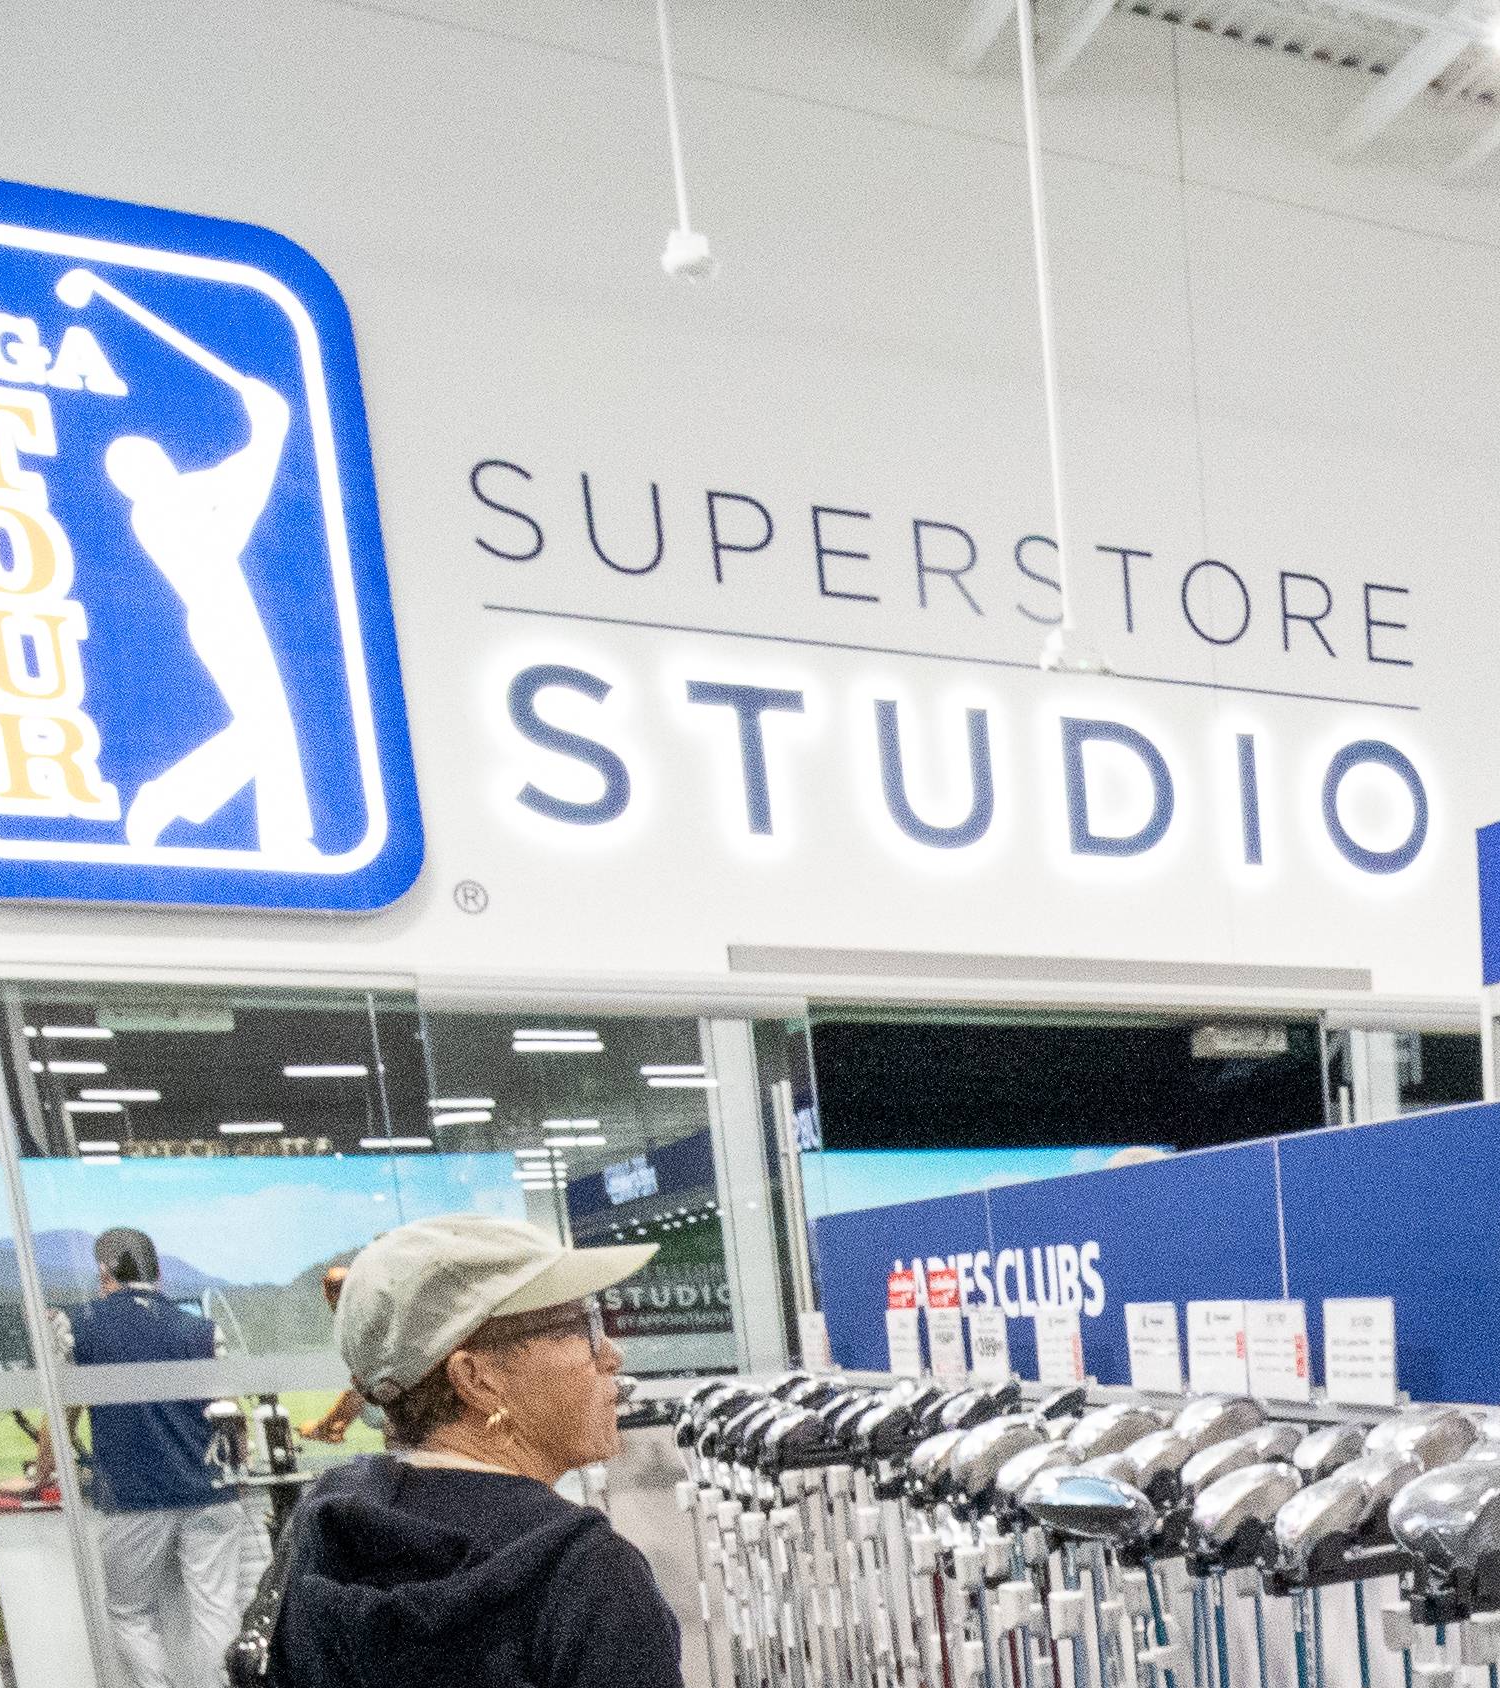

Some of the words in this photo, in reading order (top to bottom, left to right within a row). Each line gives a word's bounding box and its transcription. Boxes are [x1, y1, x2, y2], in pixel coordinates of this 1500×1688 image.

[468, 458, 1417, 667] SUPERSTORE
[504, 660, 1430, 875] STUDIO
[995, 1239, 1105, 1317] CLUBS
